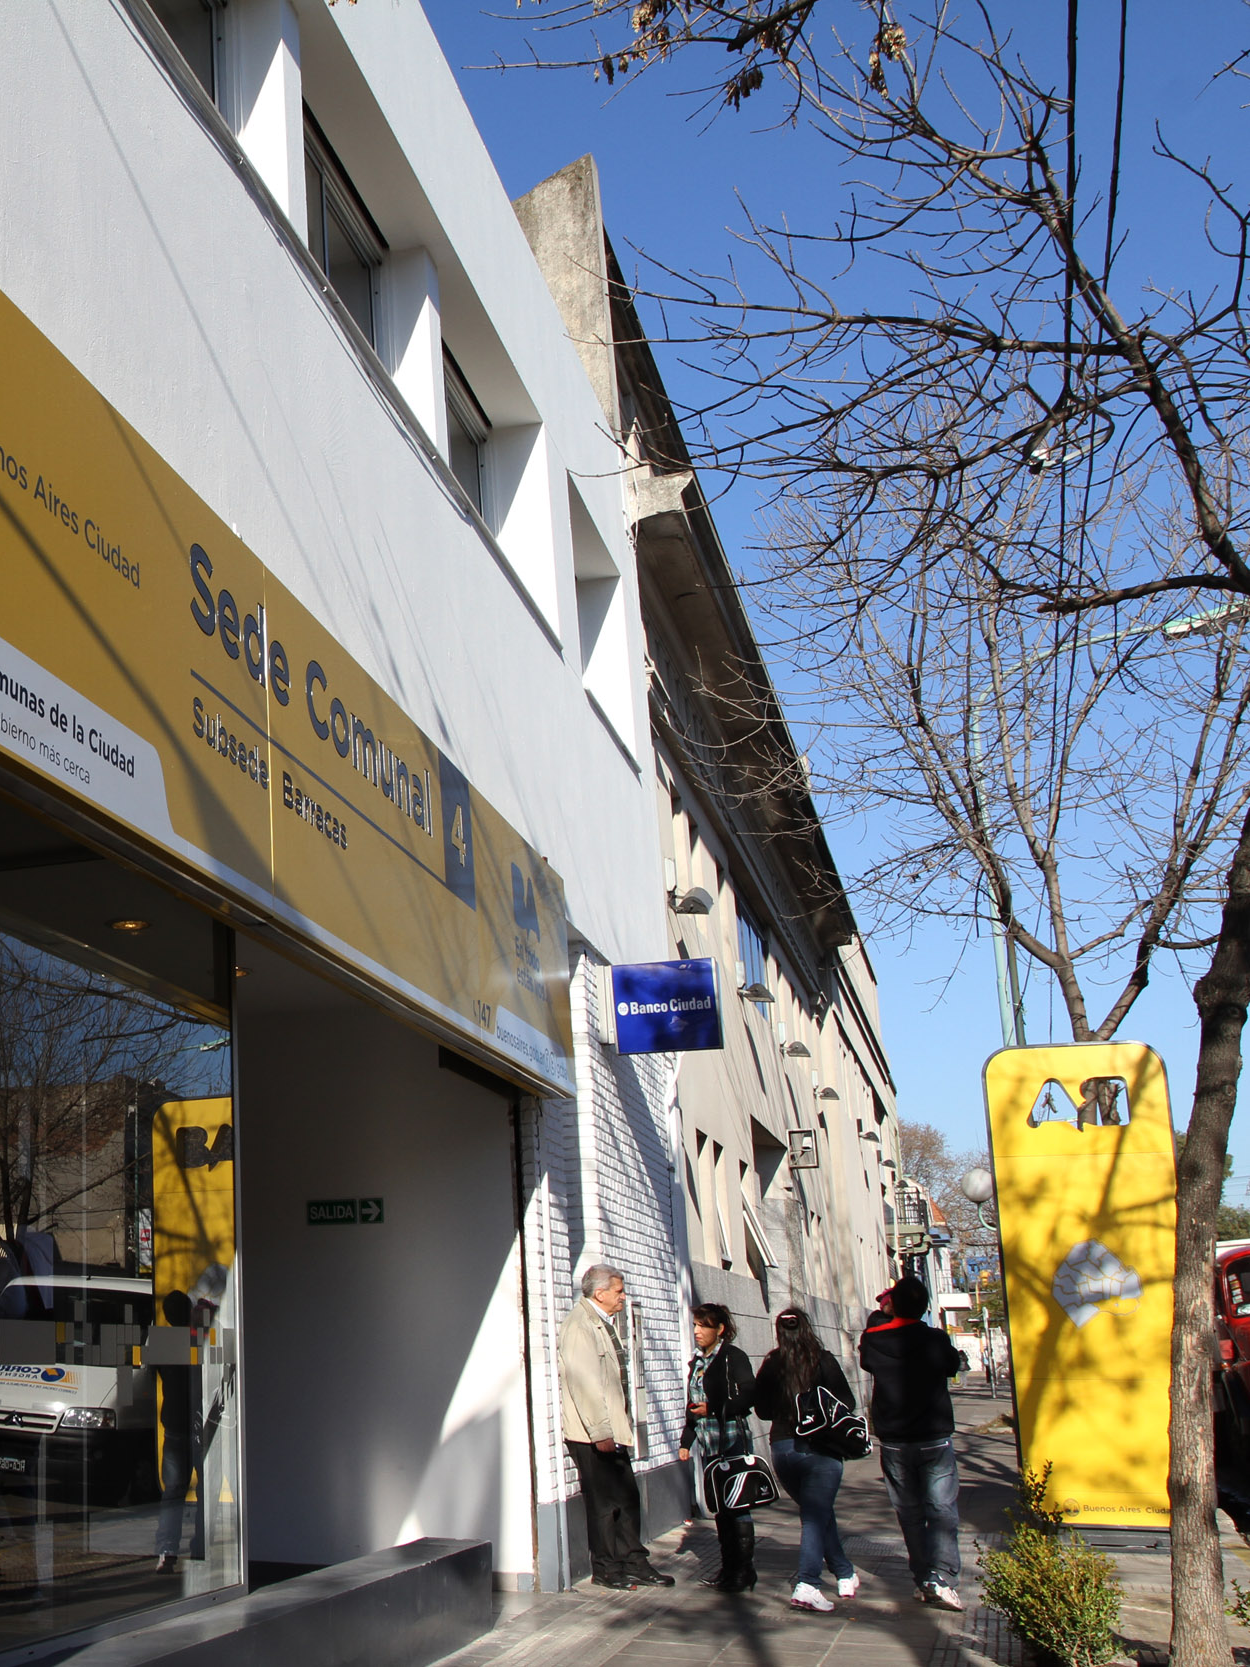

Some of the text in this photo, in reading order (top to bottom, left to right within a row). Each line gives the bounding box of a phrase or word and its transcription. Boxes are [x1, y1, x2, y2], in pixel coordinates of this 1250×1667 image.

[33, 474, 79, 535] Aires
[84, 518, 140, 589] Ciudad
[189, 542, 467, 868] Sede Comunal 4
[39, 738, 61, 766] más
[63, 756, 91, 784] cerca
[49, 702, 68, 733] de
[72, 714, 85, 745] la
[88, 728, 135, 778] Ciudad
[192, 696, 349, 851] Subsede Barracas
[477, 999, 491, 1029] 147
[629, 996, 712, 1016] Banco Ciudad
[310, 1205, 355, 1220] SALIDA
[1083, 1504, 1171, 1514] Buenos Aires Ciuda
